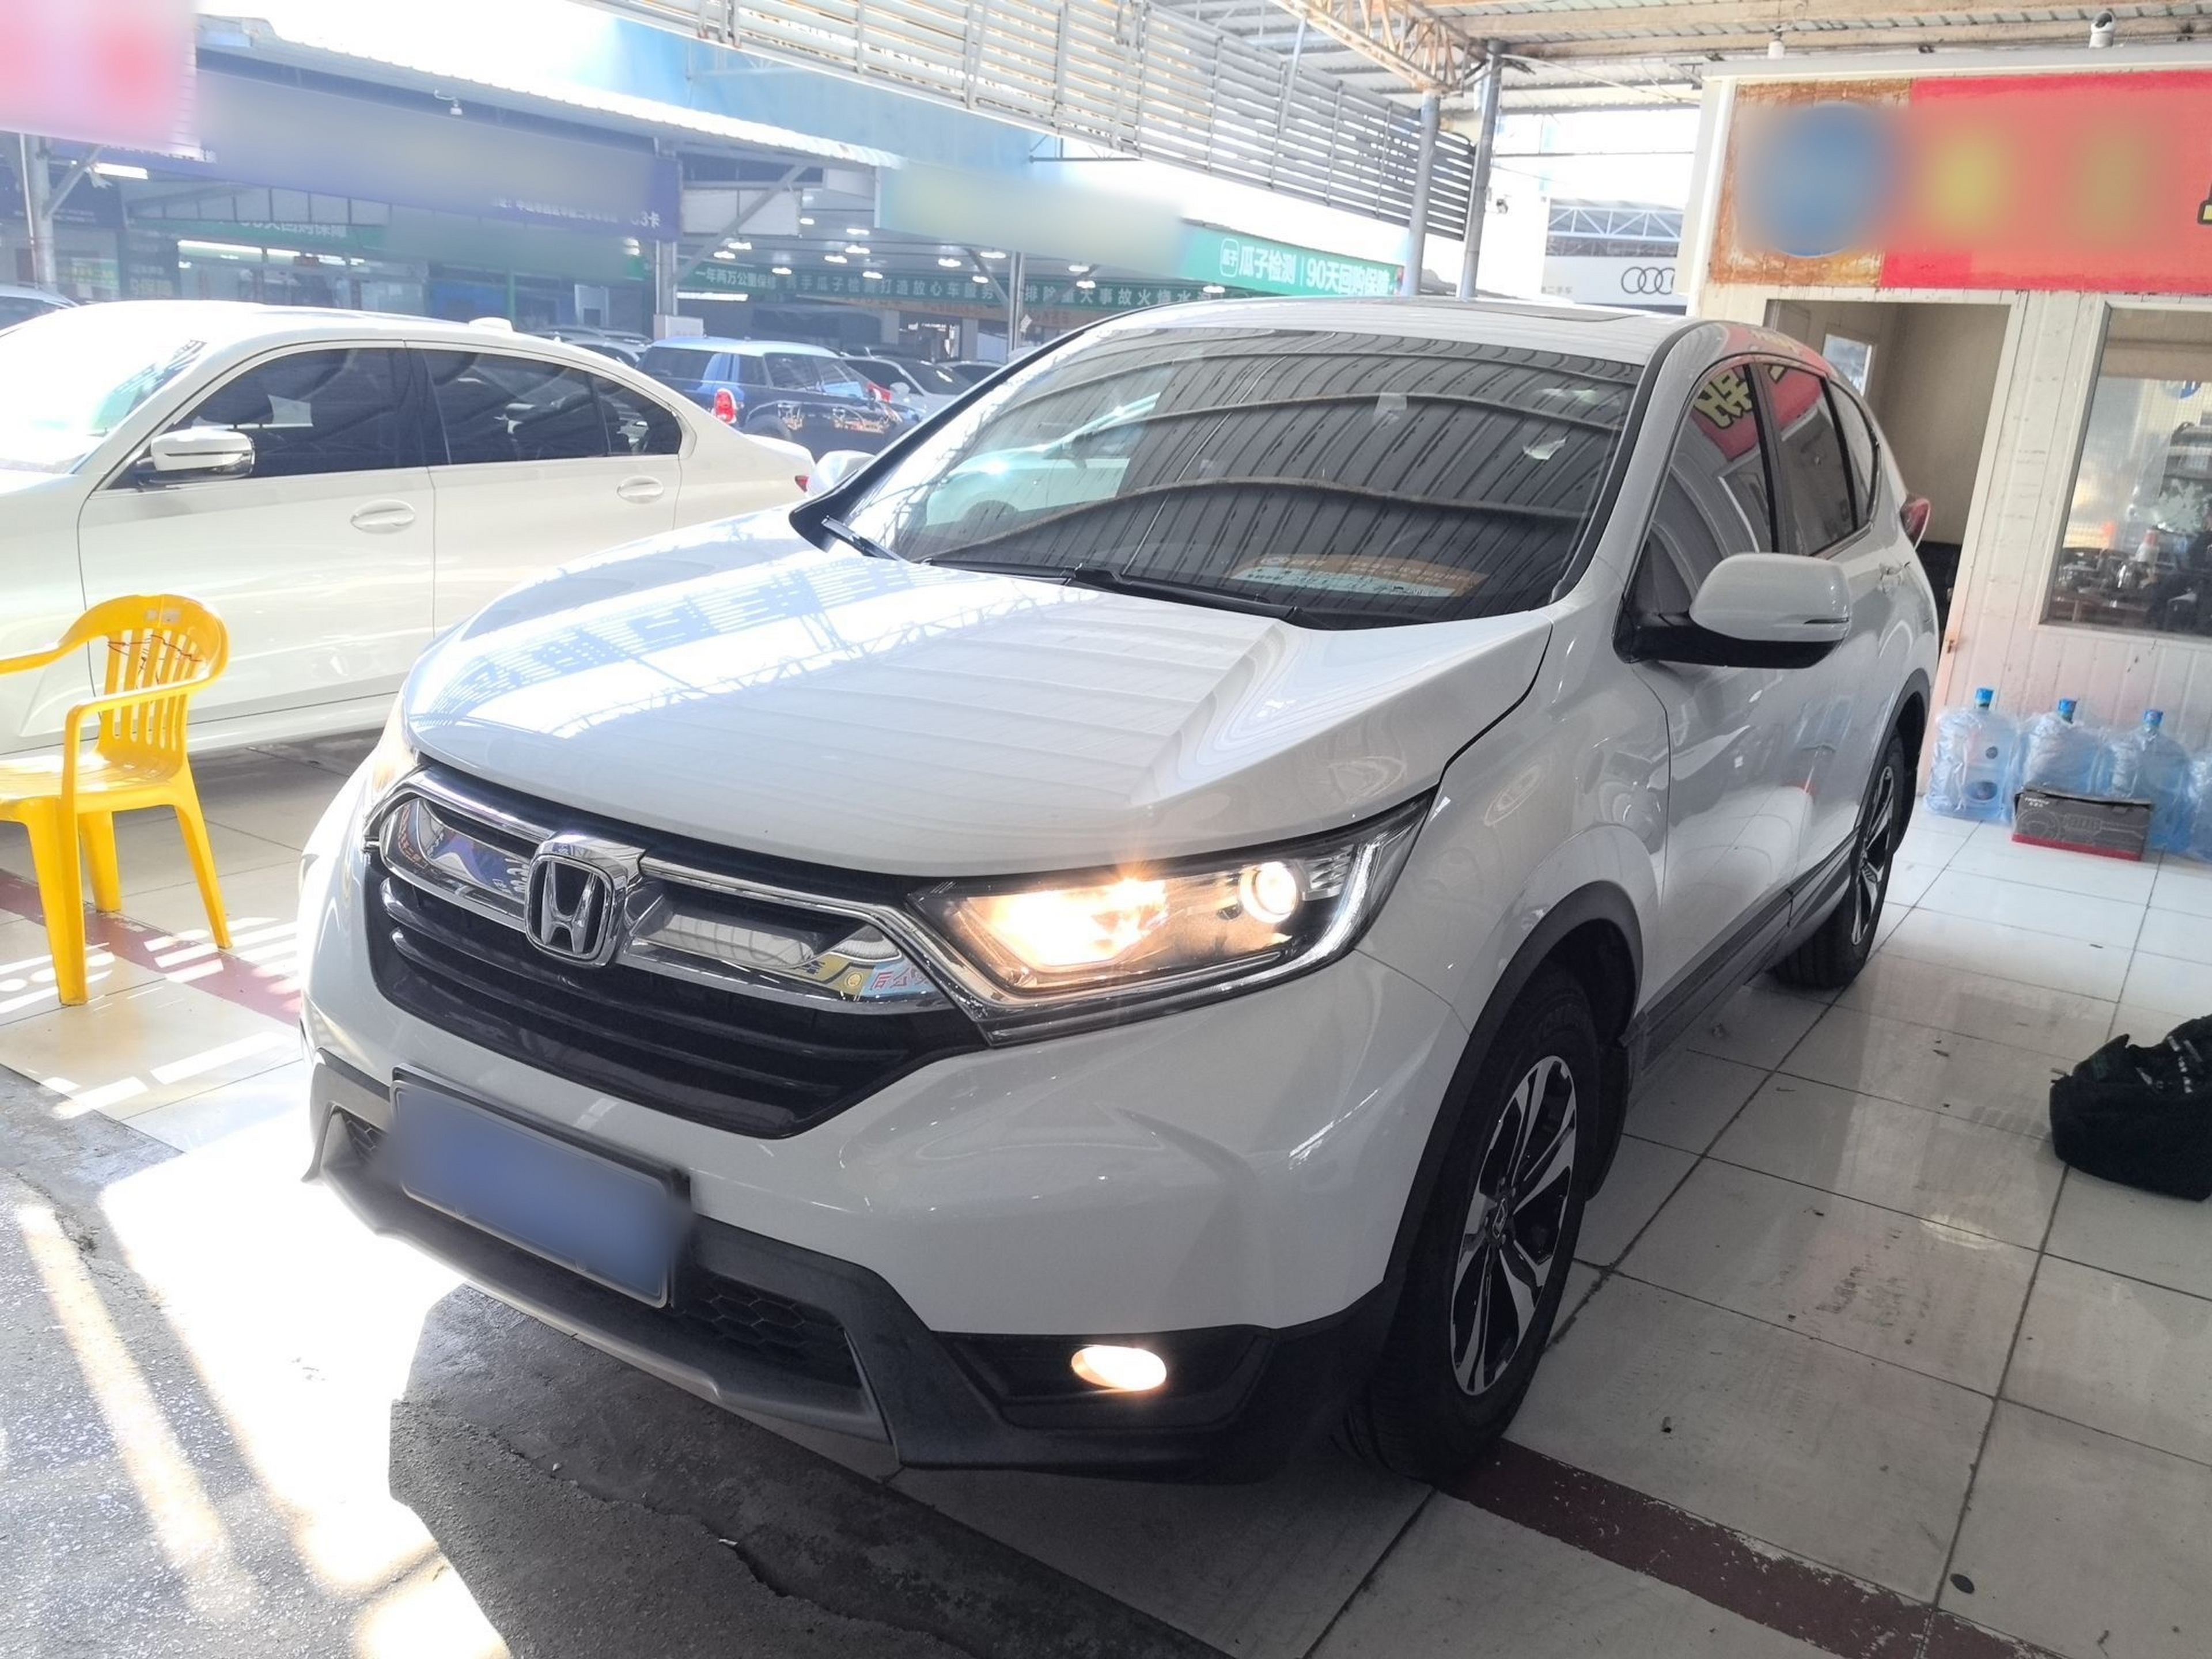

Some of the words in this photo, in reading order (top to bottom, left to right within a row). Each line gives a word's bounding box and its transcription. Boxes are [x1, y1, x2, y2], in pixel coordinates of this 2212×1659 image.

[1238, 245, 1297, 285] 瓜子检测
[1305, 257, 1390, 297] 90天回购保障
